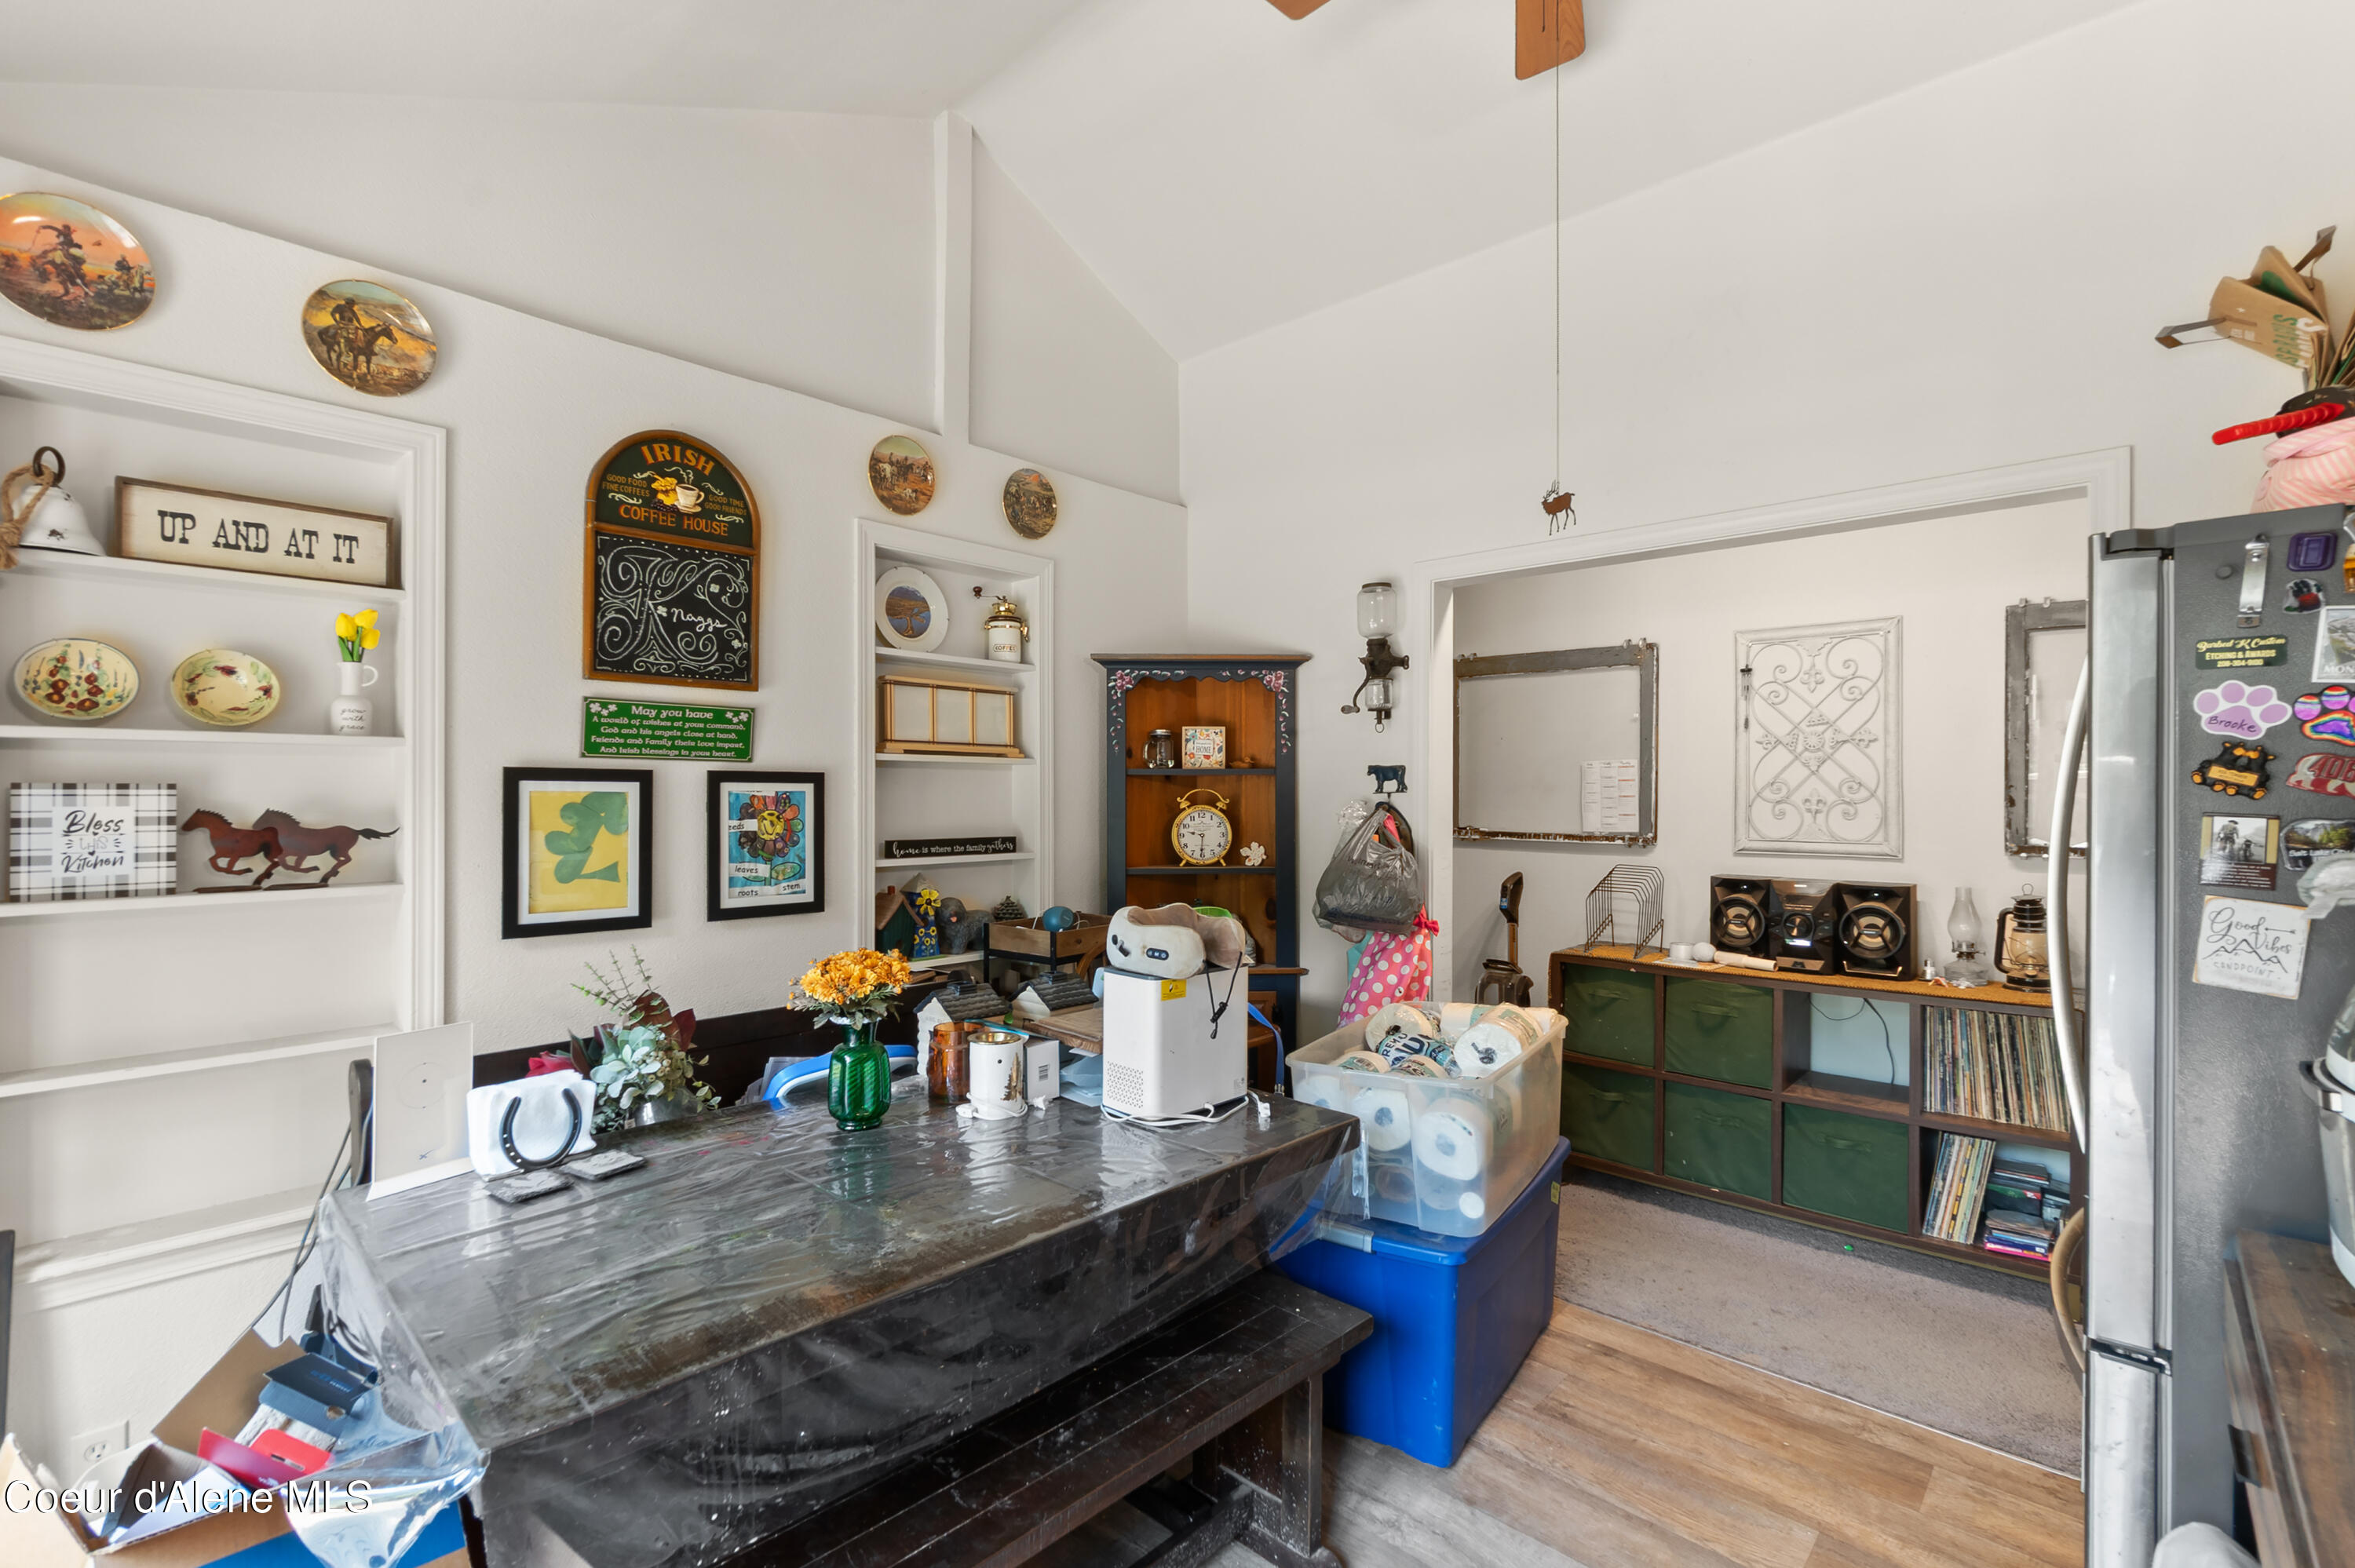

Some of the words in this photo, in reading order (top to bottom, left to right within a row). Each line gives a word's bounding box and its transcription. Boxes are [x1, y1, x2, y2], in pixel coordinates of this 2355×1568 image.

[641, 443, 715, 476] IRISH
[602, 481, 619, 492] FINE
[619, 485, 651, 498] COFFEES
[606, 473, 627, 484] GOOD
[628, 477, 648, 488] FOOD
[704, 501, 721, 511] GOOD
[708, 494, 728, 504] GOOD
[619, 503, 677, 528] COFFEE
[682, 515, 729, 537] HOUSE
[157, 509, 196, 545] UP
[212, 518, 269, 554] AND
[283, 527, 319, 560] AT
[332, 533, 360, 564] IT
[631, 706, 658, 718] May
[659, 709, 683, 719] you
[685, 709, 714, 720] have
[2207, 715, 2257, 733] Brooke
[62, 809, 125, 833] Bless
[893, 841, 922, 858] home
[966, 844, 986, 853] family
[986, 837, 1014, 854] gathers
[61, 854, 124, 873] Kitchen
[734, 865, 759, 873] leaves
[2207, 907, 2266, 946] Good
[2249, 931, 2292, 954] Vibes
